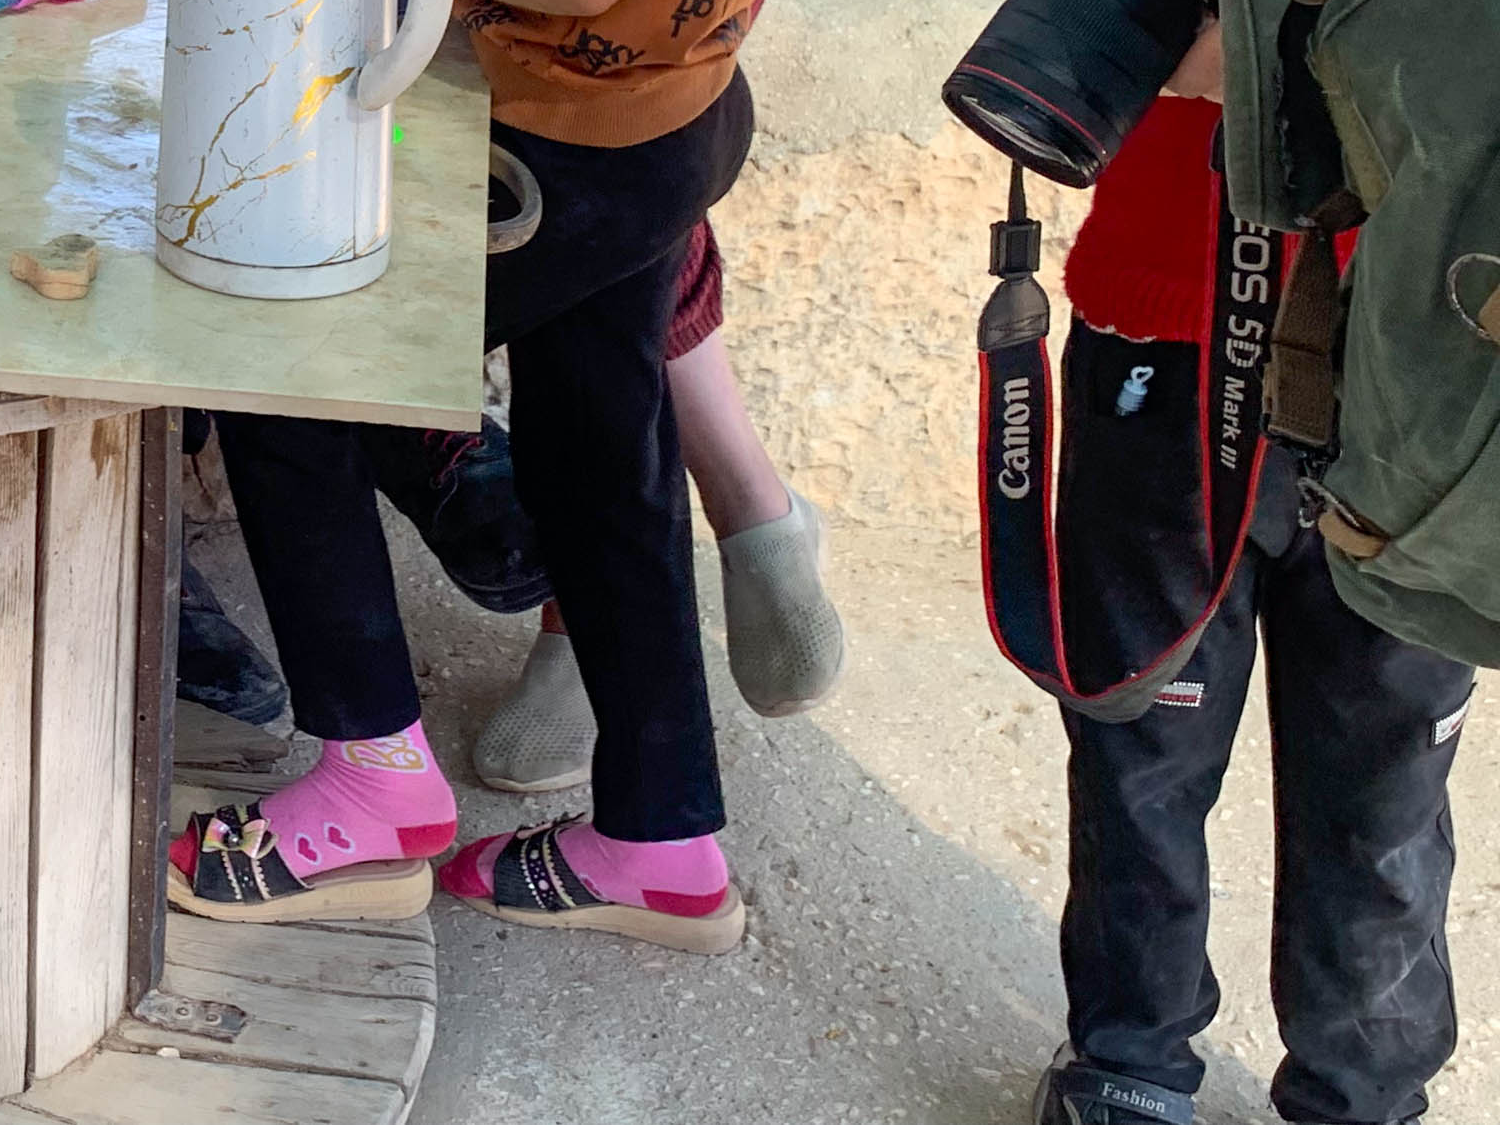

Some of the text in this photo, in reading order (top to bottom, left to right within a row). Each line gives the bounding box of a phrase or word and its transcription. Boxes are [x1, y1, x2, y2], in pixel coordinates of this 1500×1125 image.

[1225, 314, 1265, 369] 5D
[1222, 375, 1246, 442] Mark
[998, 377, 1031, 500] Canon
[1220, 443, 1238, 470] III
[1101, 1081, 1166, 1114] Fashion
